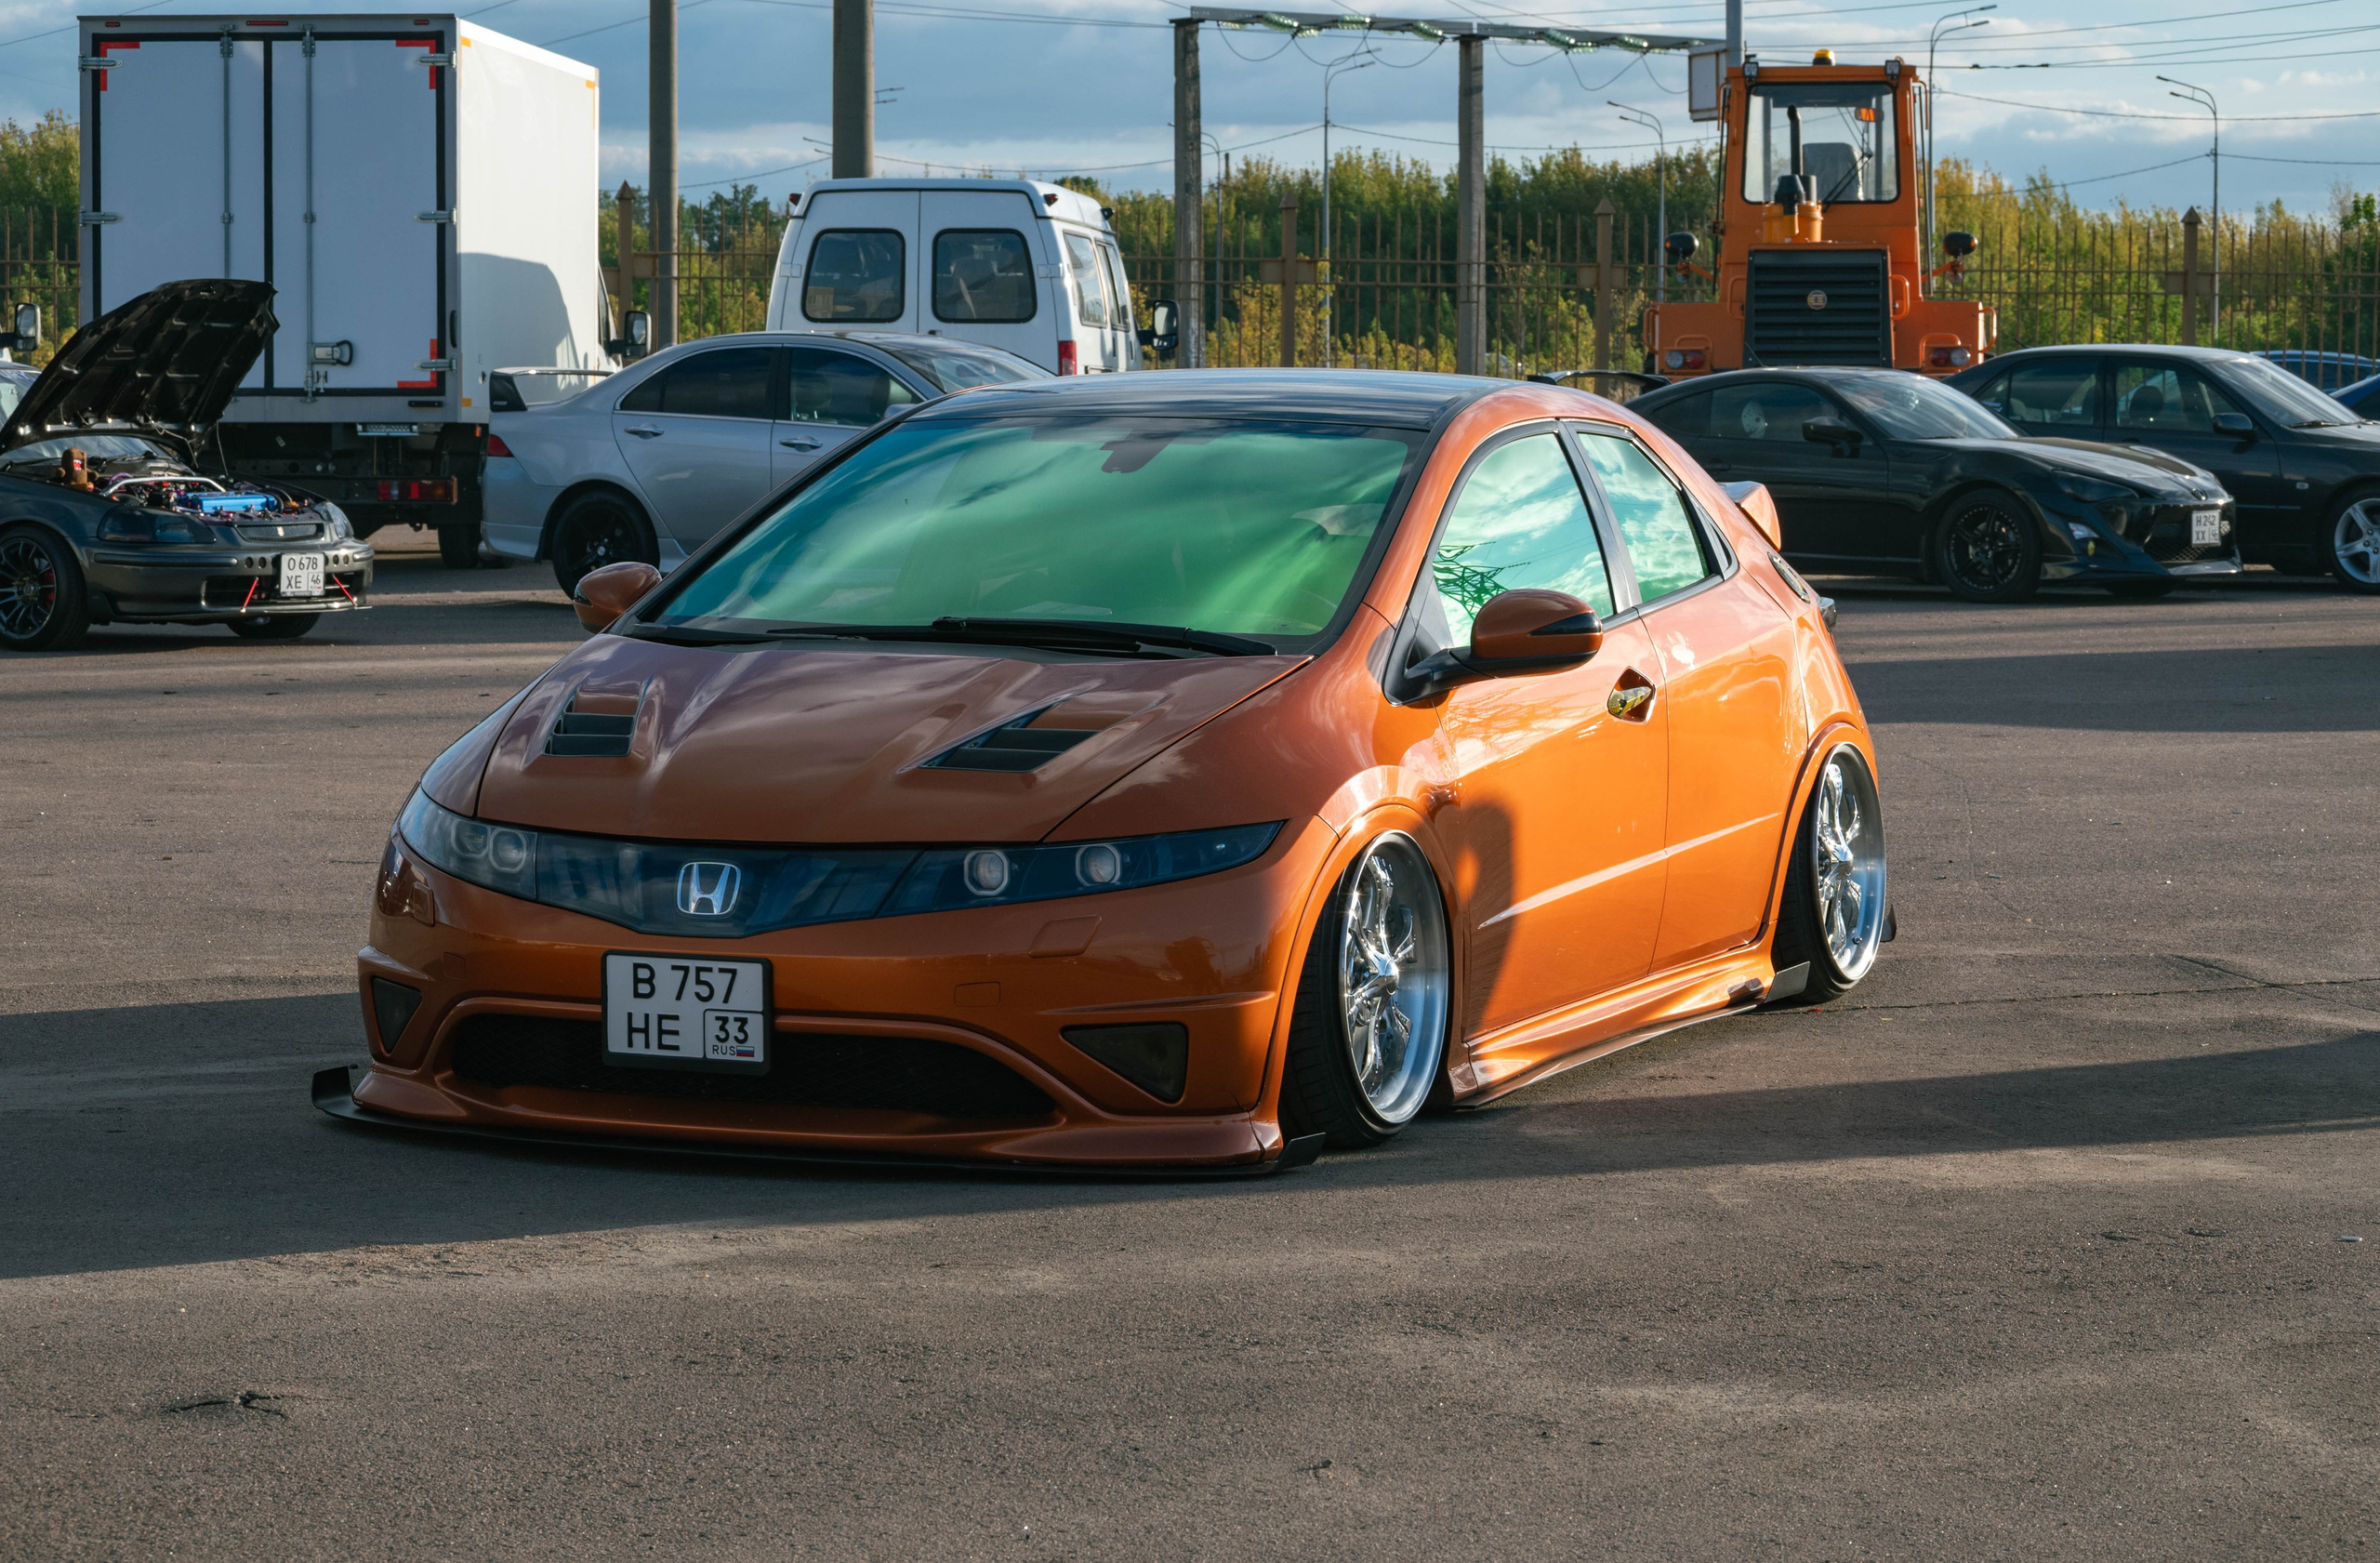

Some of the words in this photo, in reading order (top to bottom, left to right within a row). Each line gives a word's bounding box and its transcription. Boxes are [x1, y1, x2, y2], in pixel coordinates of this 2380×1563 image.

[2196, 515, 2202, 527] H
[298, 556, 318, 571] 678
[285, 575, 302, 589] XE
[311, 574, 321, 586] 46
[632, 962, 655, 999] B
[670, 964, 737, 1004] 757
[627, 1012, 681, 1052] HE
[714, 1015, 749, 1044] 33
[712, 1044, 736, 1056] RUS
